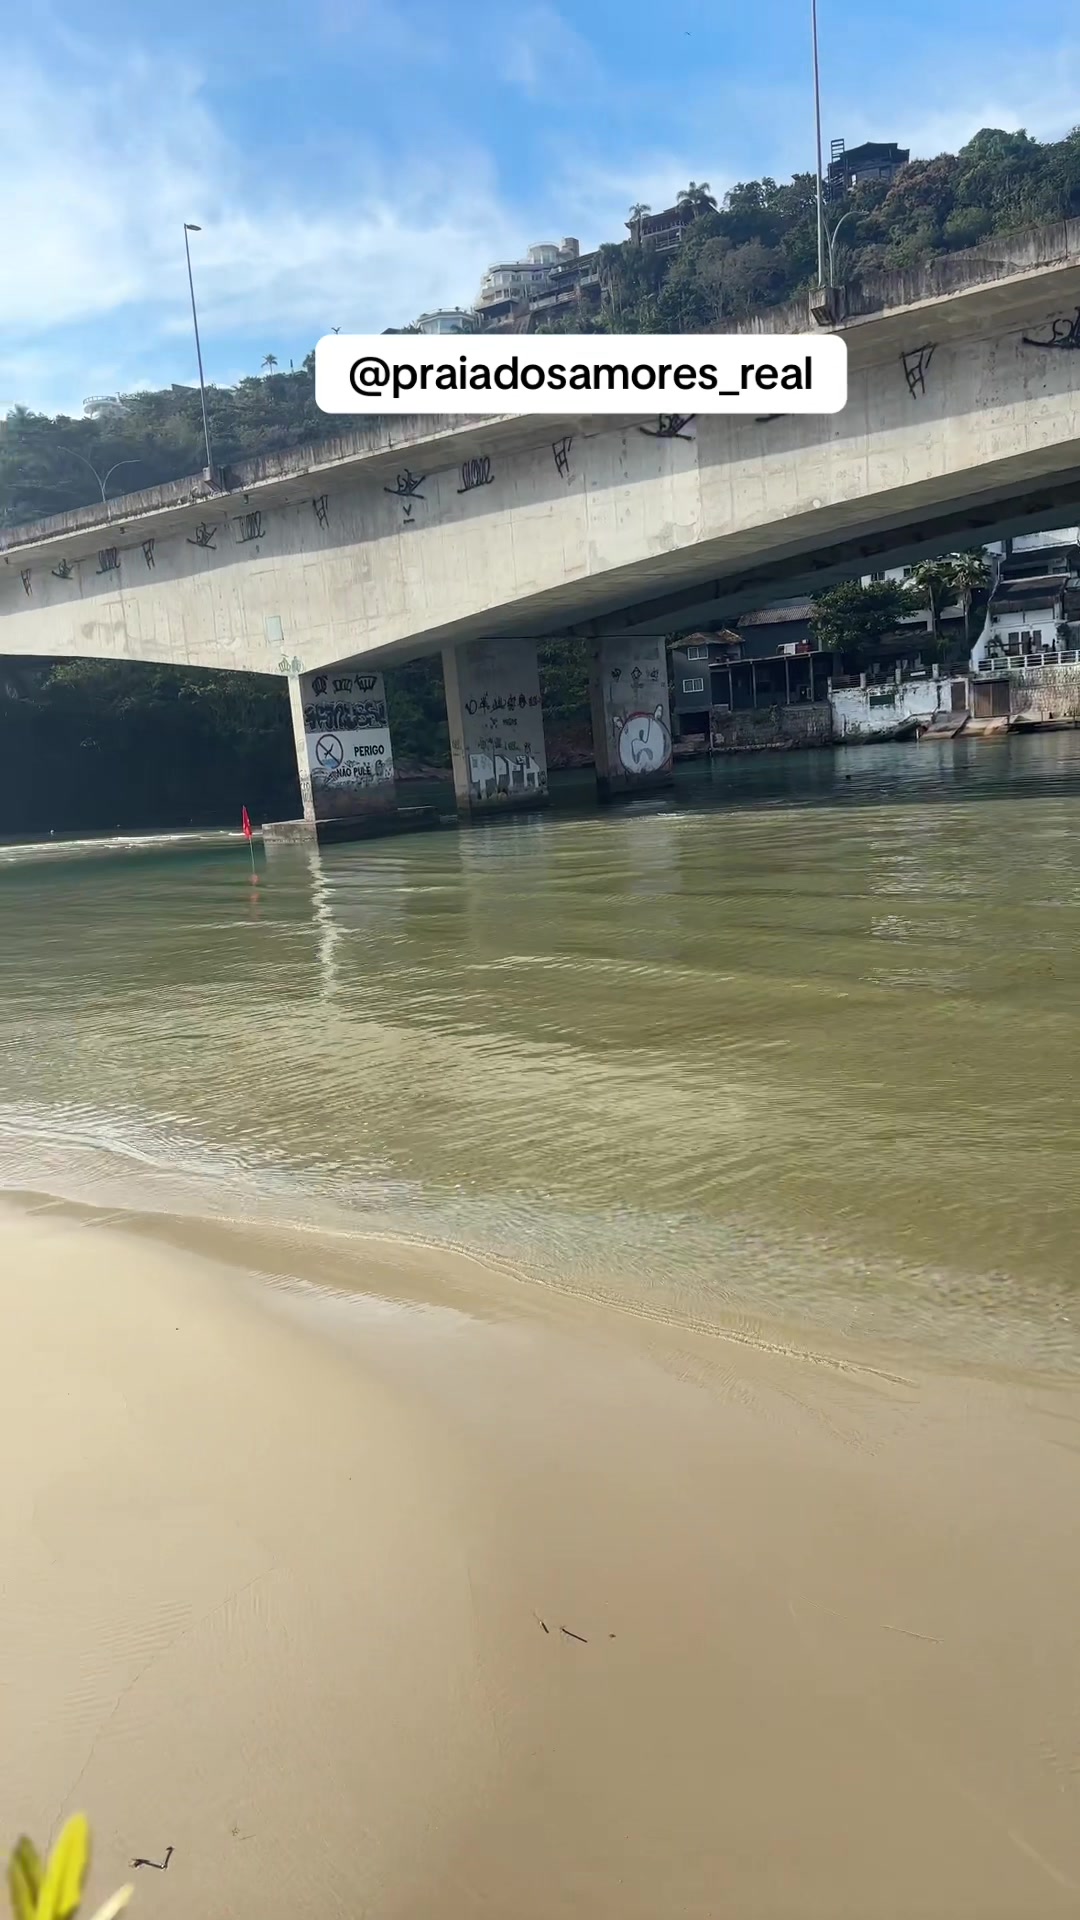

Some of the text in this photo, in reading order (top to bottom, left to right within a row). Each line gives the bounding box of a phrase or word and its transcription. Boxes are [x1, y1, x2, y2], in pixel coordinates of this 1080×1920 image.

[354, 744, 385, 757] PERIGO
[337, 765, 352, 777] NÃO
[354, 766, 371, 776] PULE
